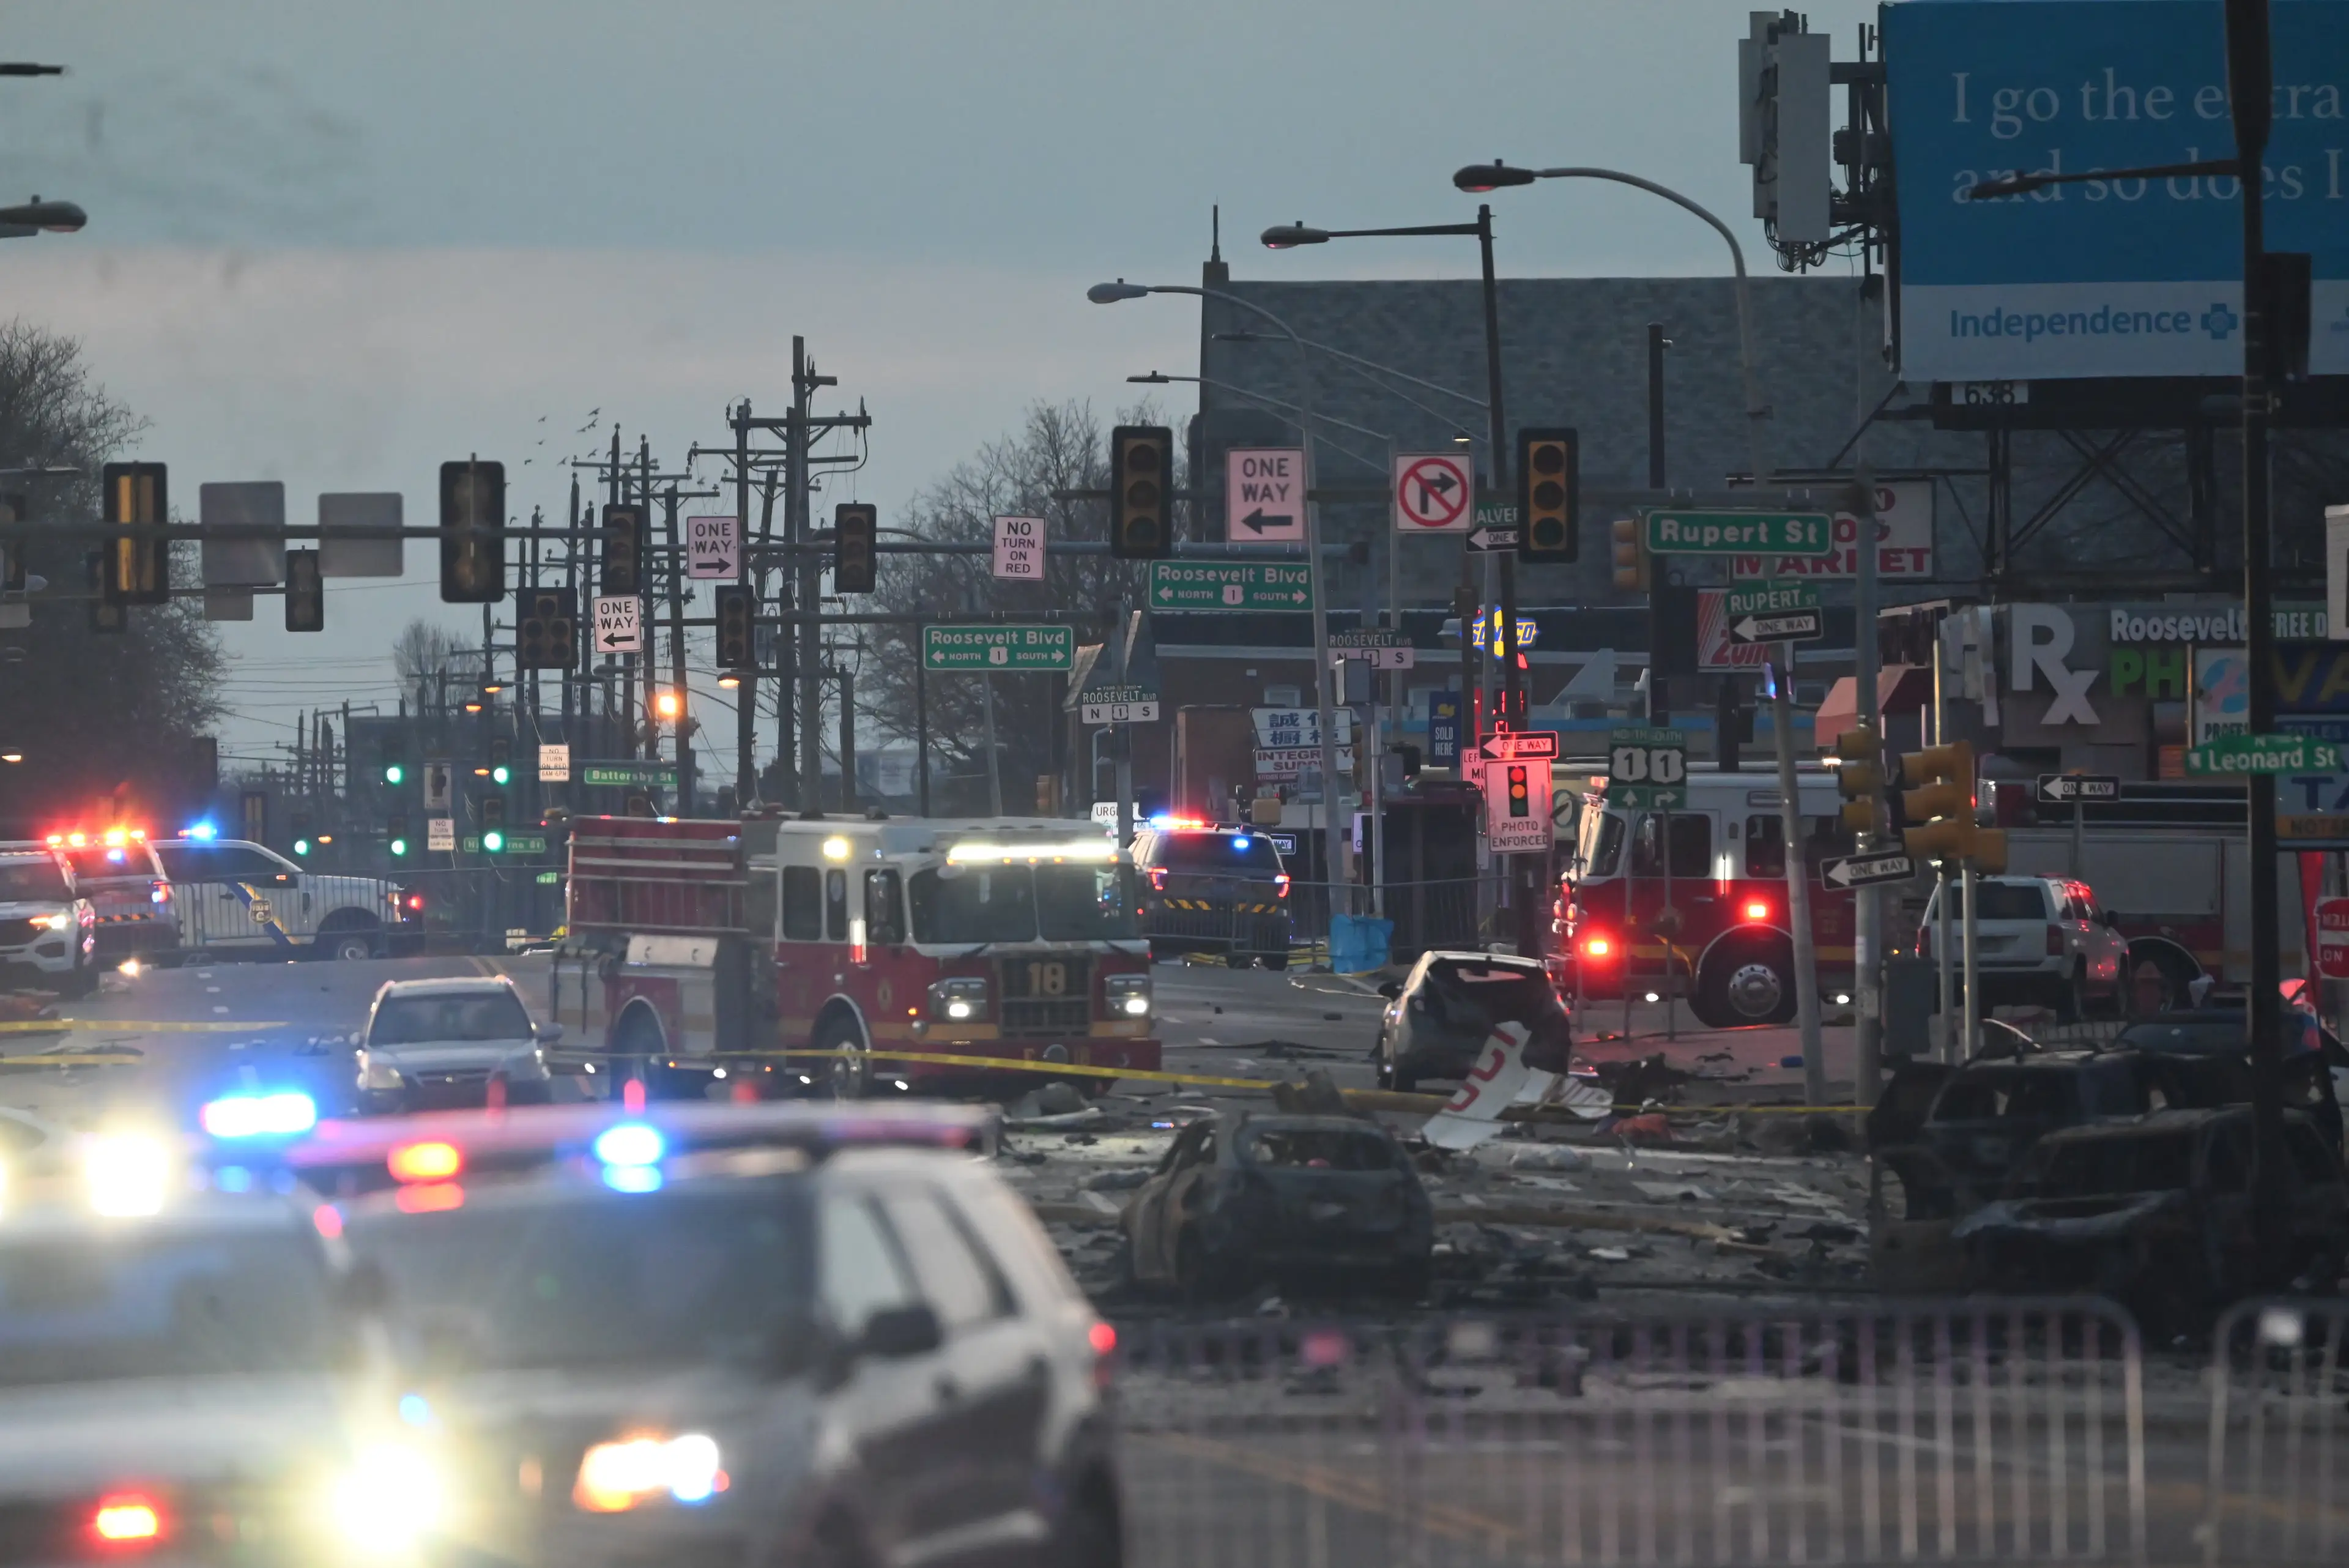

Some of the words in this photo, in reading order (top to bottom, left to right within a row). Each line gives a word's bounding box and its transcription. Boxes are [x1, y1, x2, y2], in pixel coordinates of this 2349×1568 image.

[1952, 72, 1971, 122] I
[1990, 86, 2060, 140] go
[2080, 67, 2175, 121] the
[2194, 82, 2343, 121] etra
[2084, 166, 2147, 203] so
[1951, 305, 2191, 343] Independence
[1242, 458, 1290, 478] ONE
[1241, 483, 1290, 503] WAY
[695, 522, 731, 537] ONE
[1007, 521, 1031, 536] NO
[1660, 519, 1769, 547] Rupert
[1784, 519, 1818, 544] St
[1001, 538, 1035, 549] TURN
[1488, 532, 1510, 543] ONE
[695, 540, 732, 554] WAY
[1010, 551, 1027, 561] ON
[1735, 548, 1931, 575] MARET
[1006, 563, 1031, 574] RED
[1158, 565, 1256, 582] Roosevelt
[1264, 567, 1308, 584] Blvd
[1178, 590, 1214, 600] NORTH
[1231, 589, 1236, 601] 1
[1253, 592, 1288, 601] SOUTH
[1730, 589, 1801, 612] RUPERT
[600, 601, 633, 615] ONE
[600, 615, 634, 630] WAY
[1756, 620, 1783, 634] ONE
[1784, 618, 1811, 631] WAY
[931, 631, 1019, 645] Roosevelt
[1026, 631, 1065, 644] Blvd
[1329, 634, 1393, 647] ROOSEVELT
[997, 650, 1001, 661] 1
[1395, 652, 1405, 664] S
[1082, 691, 1140, 703] ROOSEVELT
[1142, 693, 1157, 701] BLVD
[1091, 708, 1100, 719] N
[1142, 706, 1150, 716] S
[1435, 726, 1453, 740] SOLD
[1435, 742, 1453, 756] HERE
[1527, 740, 1549, 751] WAY
[1258, 748, 1351, 761] INTEGRY
[1463, 753, 1482, 764] LEF
[2208, 746, 2304, 771] Leonard
[2313, 746, 2337, 768] St
[1624, 752, 1633, 776] 1
[1659, 754, 1669, 778] 1
[592, 770, 654, 783] Battersby
[659, 772, 672, 781] St
[2062, 783, 2085, 793] ONE
[2088, 783, 2110, 794] WAY
[1501, 821, 1538, 832] PHOTO
[1492, 835, 1548, 848] ENFORCED
[1850, 863, 1876, 877] ONE
[1879, 859, 1905, 872] WAY
[1026, 962, 1067, 995] 18
